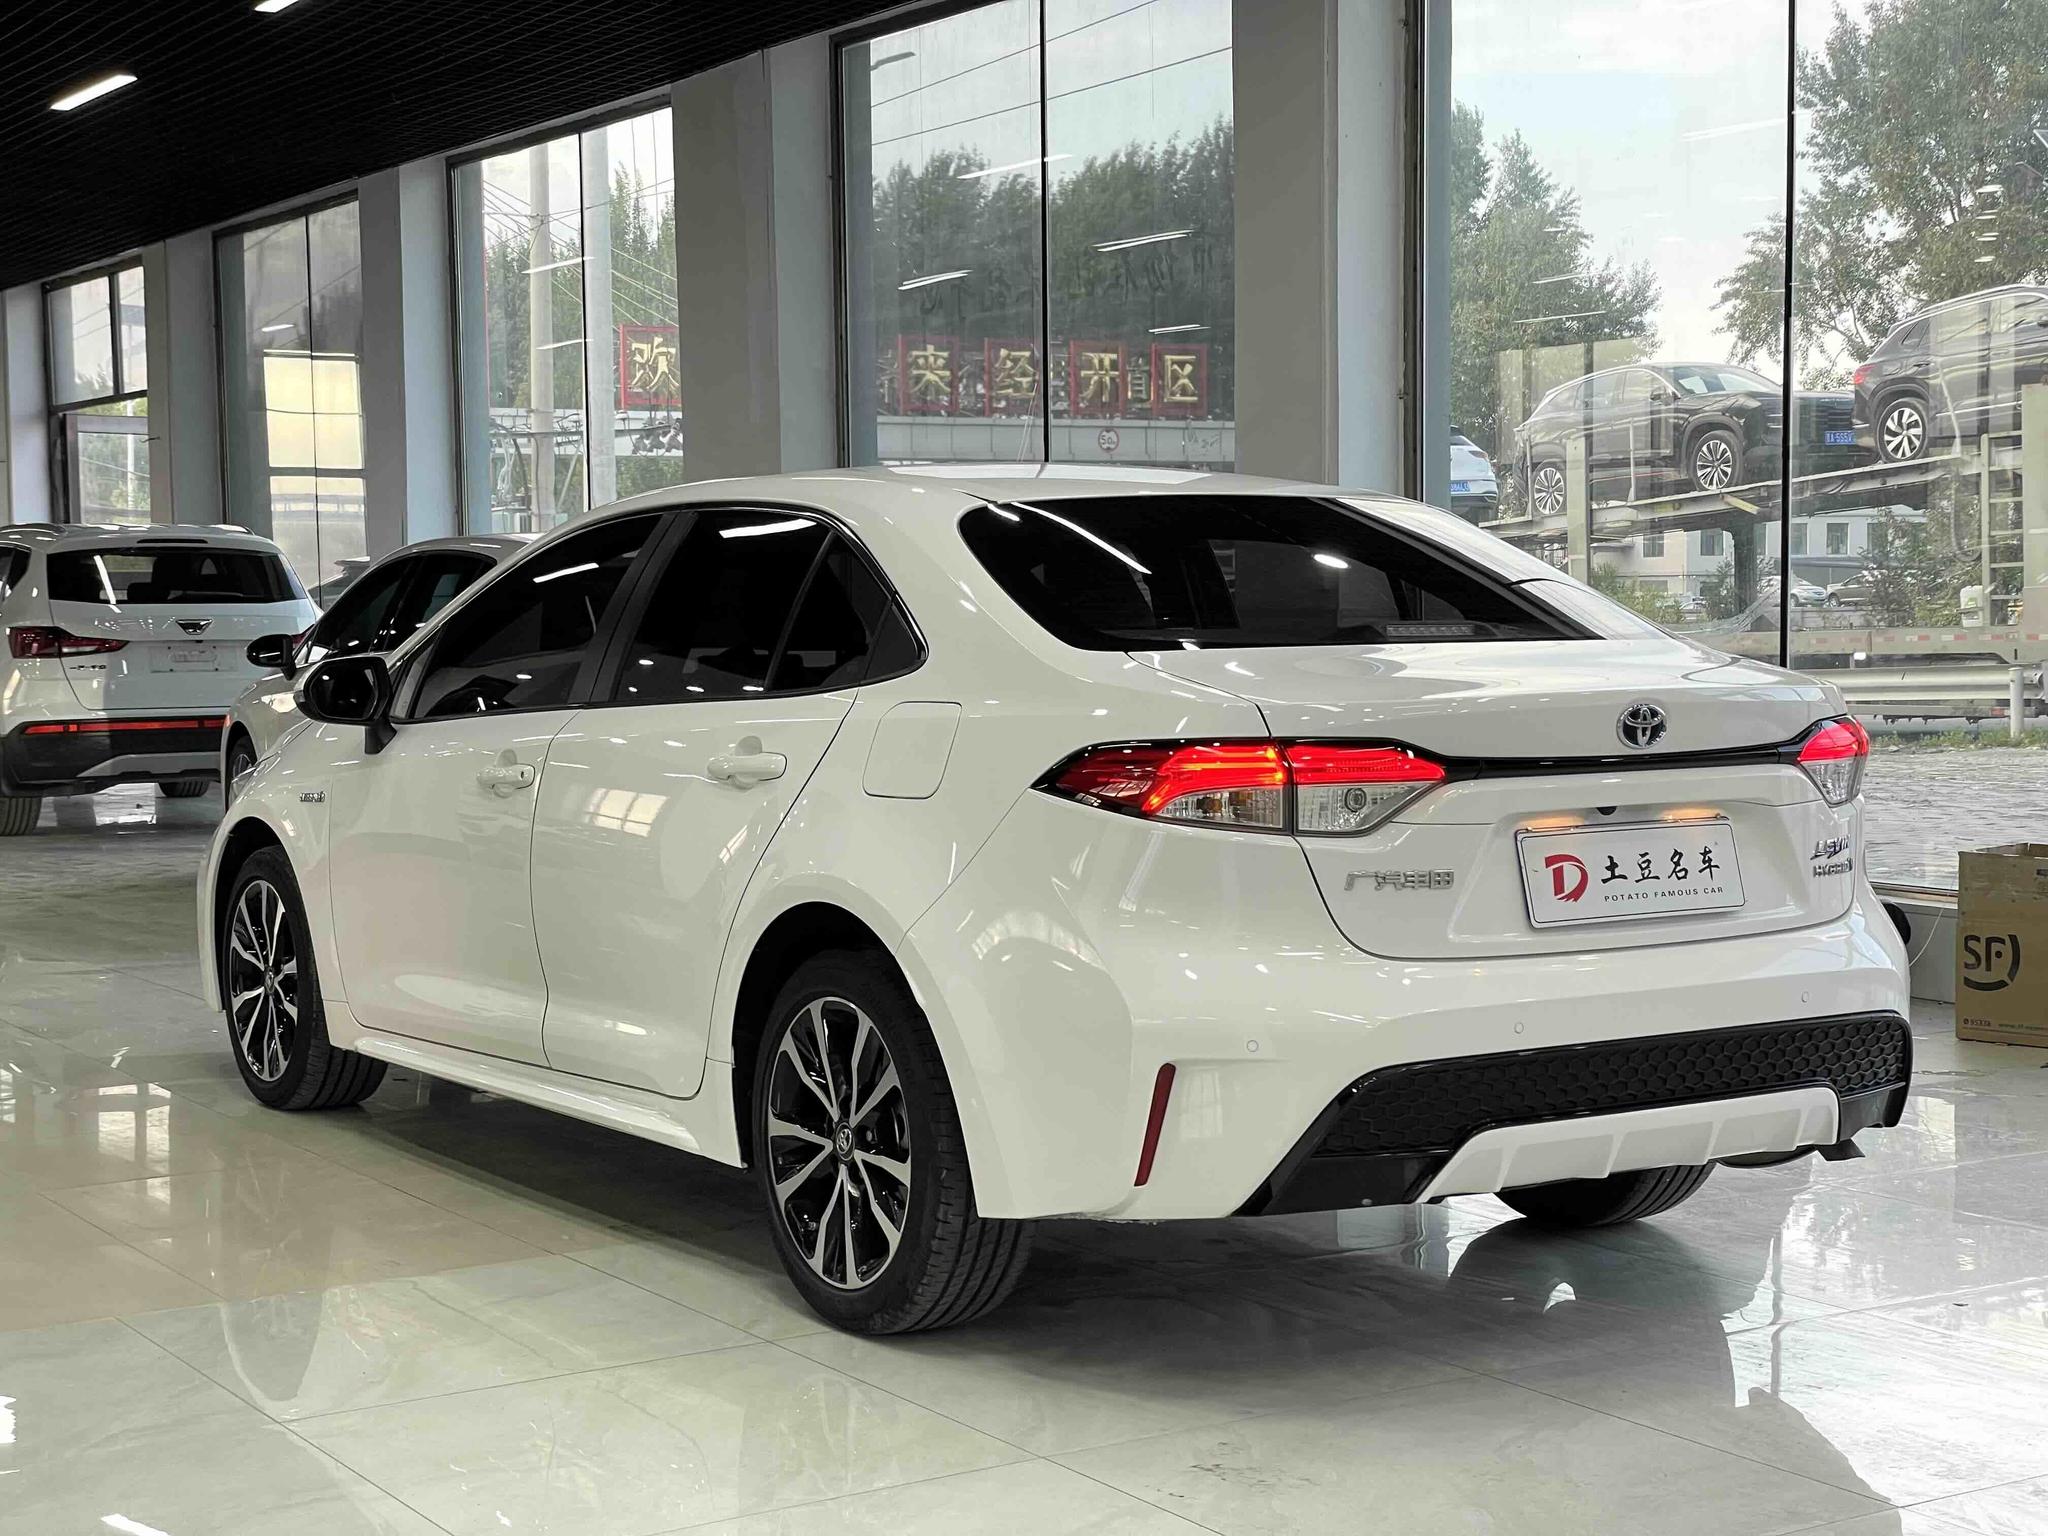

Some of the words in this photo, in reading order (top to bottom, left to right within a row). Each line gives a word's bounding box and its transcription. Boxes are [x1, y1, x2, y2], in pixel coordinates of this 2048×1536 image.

[632, 336, 679, 389] 欢
[1600, 845, 1721, 885] 土豆名车
[1604, 891, 1649, 903] POTATO
[1654, 888, 1699, 899] FAMOUS
[1703, 886, 1724, 895] CAR
